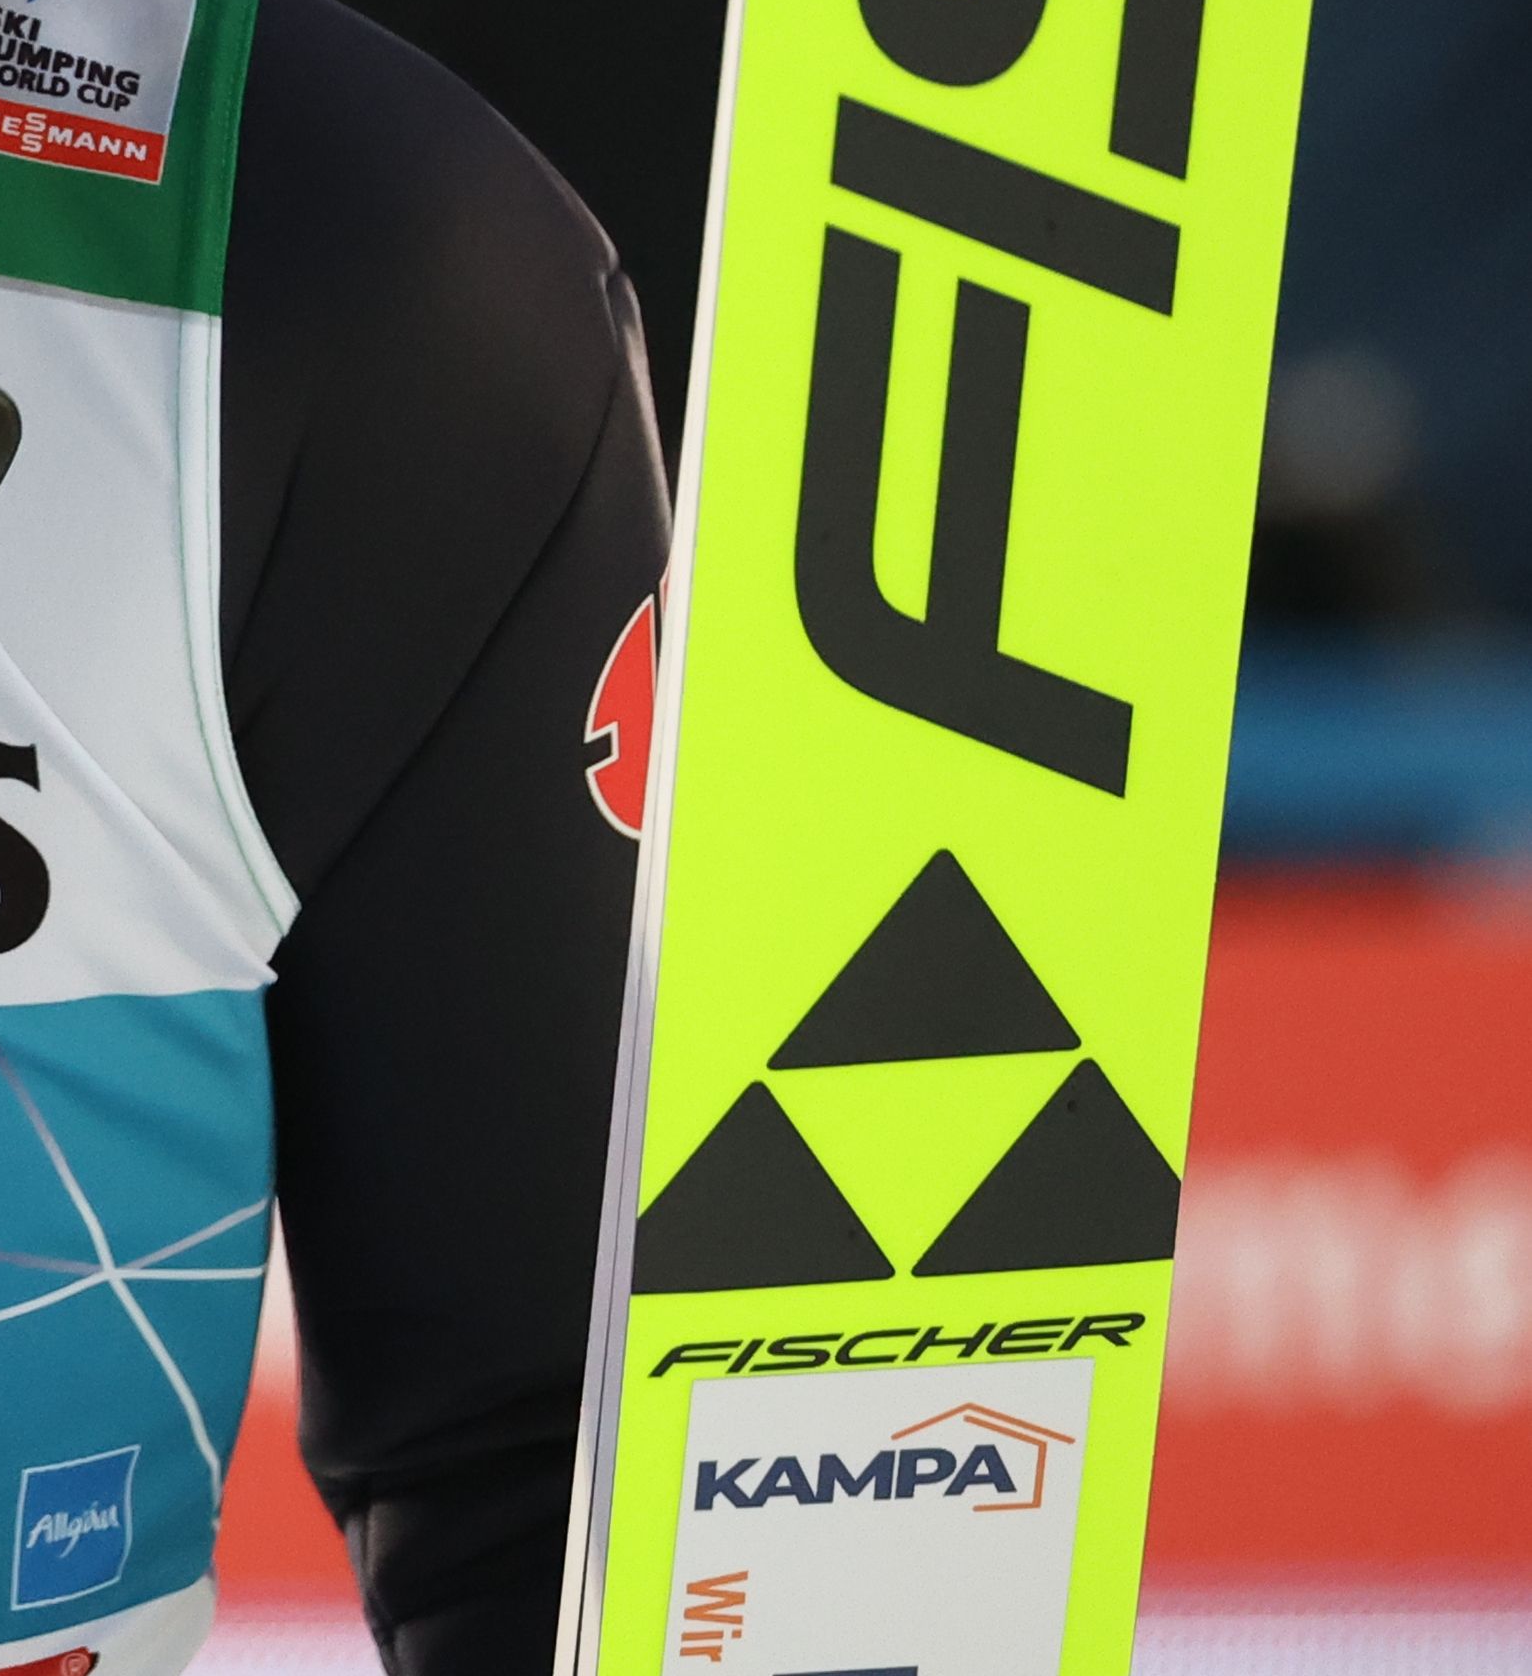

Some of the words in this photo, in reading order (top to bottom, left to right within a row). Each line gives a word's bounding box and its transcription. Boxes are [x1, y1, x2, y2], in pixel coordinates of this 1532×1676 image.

[77, 84, 132, 112] CUP
[647, 1311, 1146, 1379] FISCHER
[694, 1443, 1017, 1511] KAMPA
[679, 1570, 749, 1663] Wir
